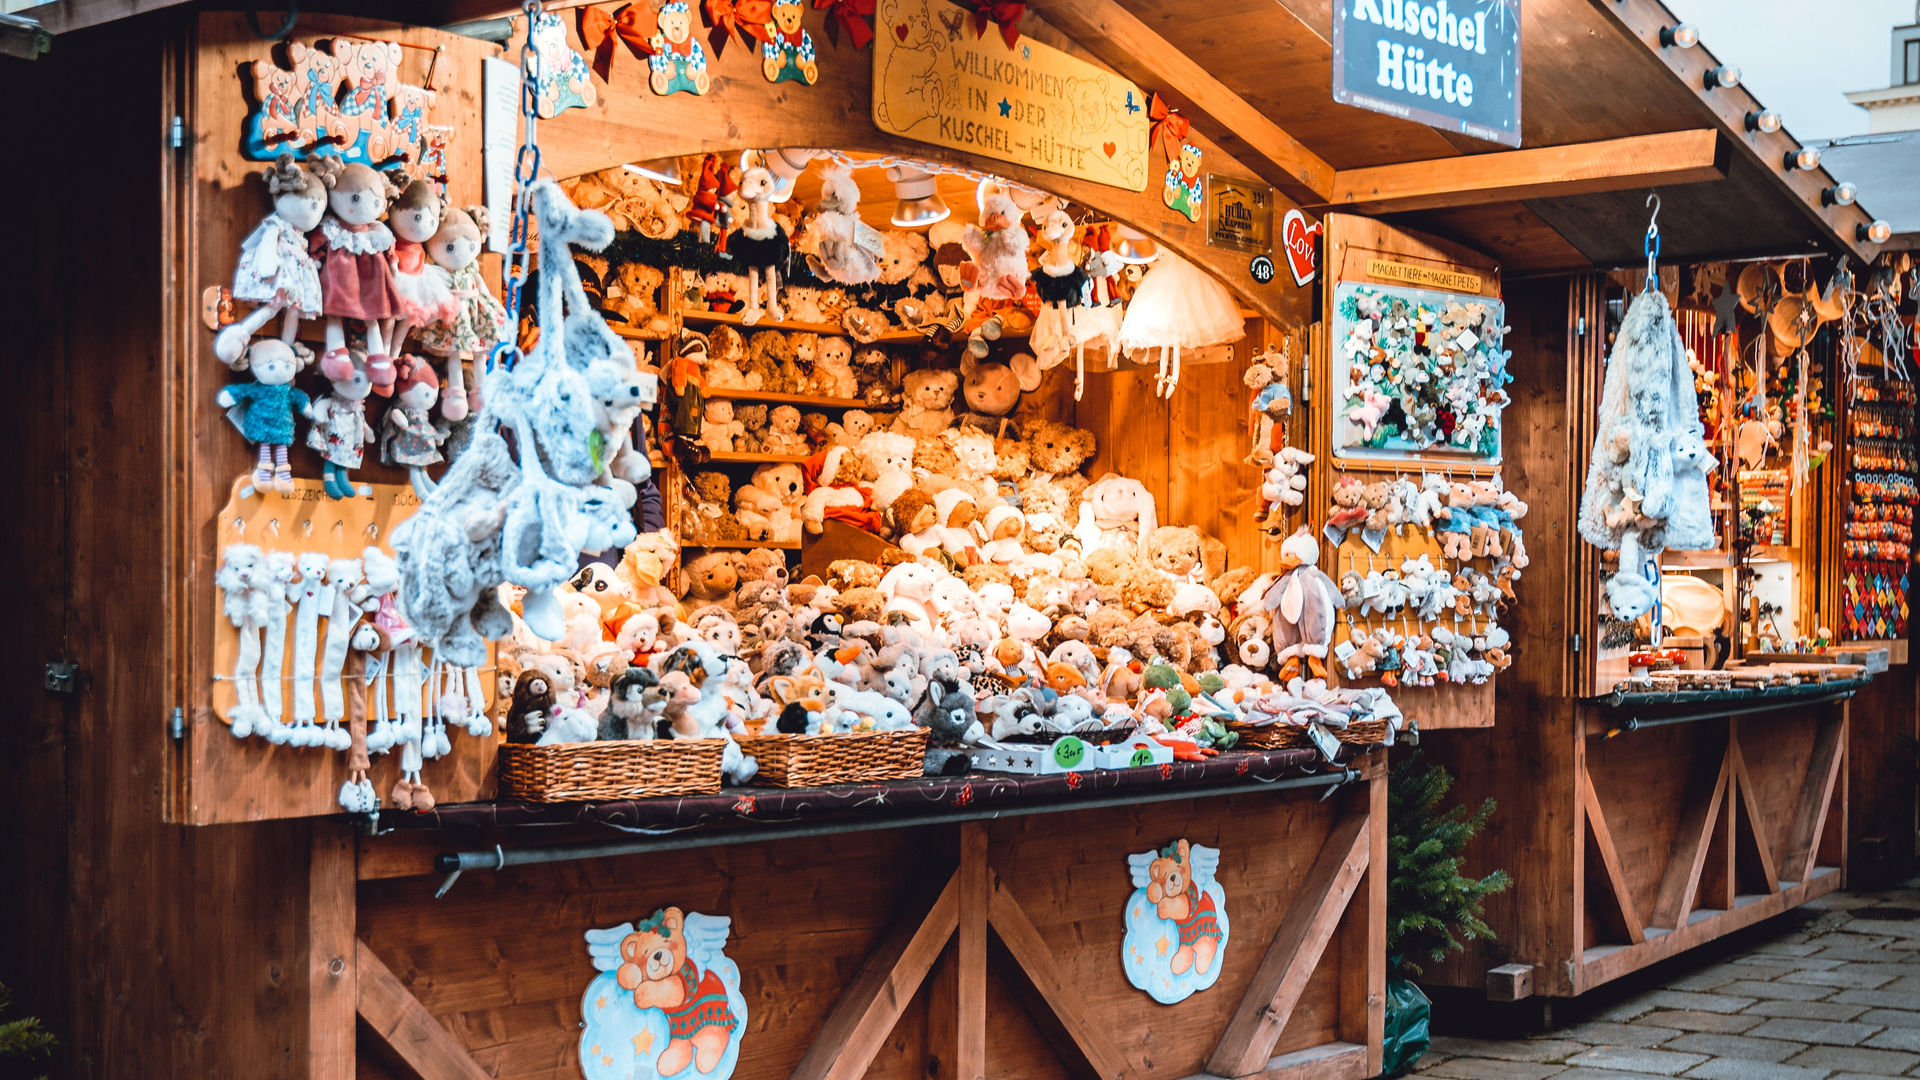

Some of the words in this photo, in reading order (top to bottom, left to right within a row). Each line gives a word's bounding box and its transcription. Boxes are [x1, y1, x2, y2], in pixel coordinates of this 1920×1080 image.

[951, 46, 1064, 99] WILLKOMMEN
[1377, 39, 1473, 107] Hütte
[968, 87, 988, 112] IN
[1014, 99, 1046, 128] DER
[1255, 264, 1270, 280] 48
